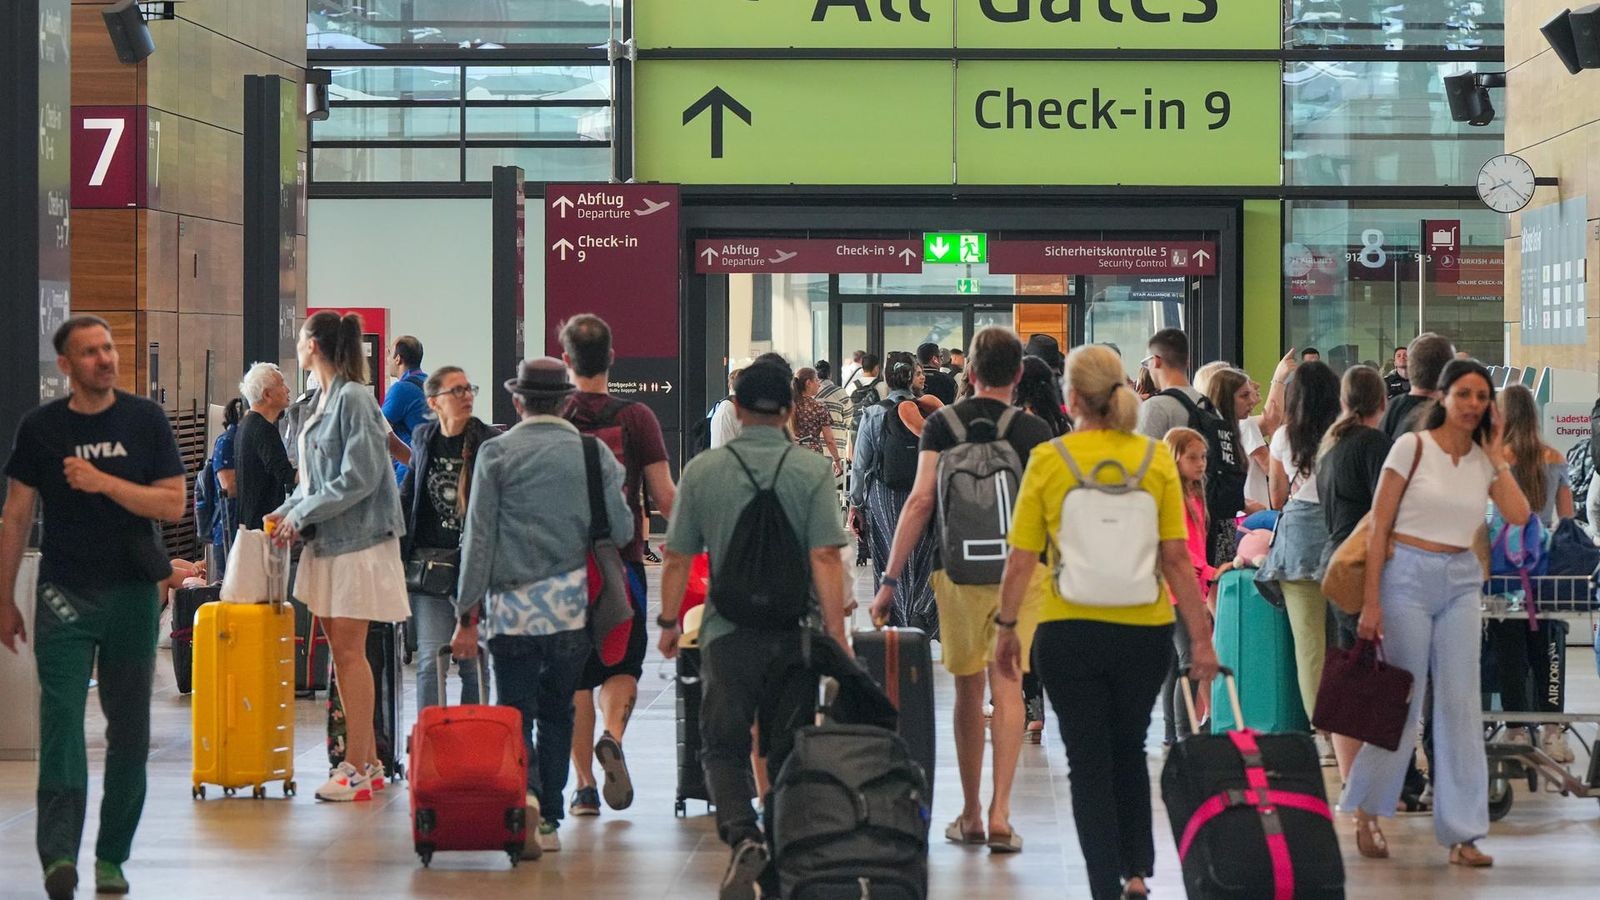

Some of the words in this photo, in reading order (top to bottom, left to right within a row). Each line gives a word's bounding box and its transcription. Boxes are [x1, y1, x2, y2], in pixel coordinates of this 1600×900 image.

[975, 88, 1185, 130] Check-in
[1204, 91, 1231, 130] 9
[83, 118, 125, 186] 7
[577, 193, 624, 208] Abflug
[577, 209, 631, 220] Departure
[578, 235, 638, 247] Check-in
[722, 245, 760, 257] Abflug
[836, 245, 885, 256] Check-in
[888, 246, 895, 256] 9
[1045, 246, 1157, 257] Sicherheitskontrolle
[1160, 246, 1167, 257] 5
[1360, 229, 1387, 268] 8
[577, 250, 586, 262] 9
[722, 257, 765, 267] Departure
[1457, 257, 1488, 265] TURKISH
[1098, 259, 1133, 269] Security
[1135, 259, 1167, 268] Control
[1548, 684, 1559, 706] AIR
